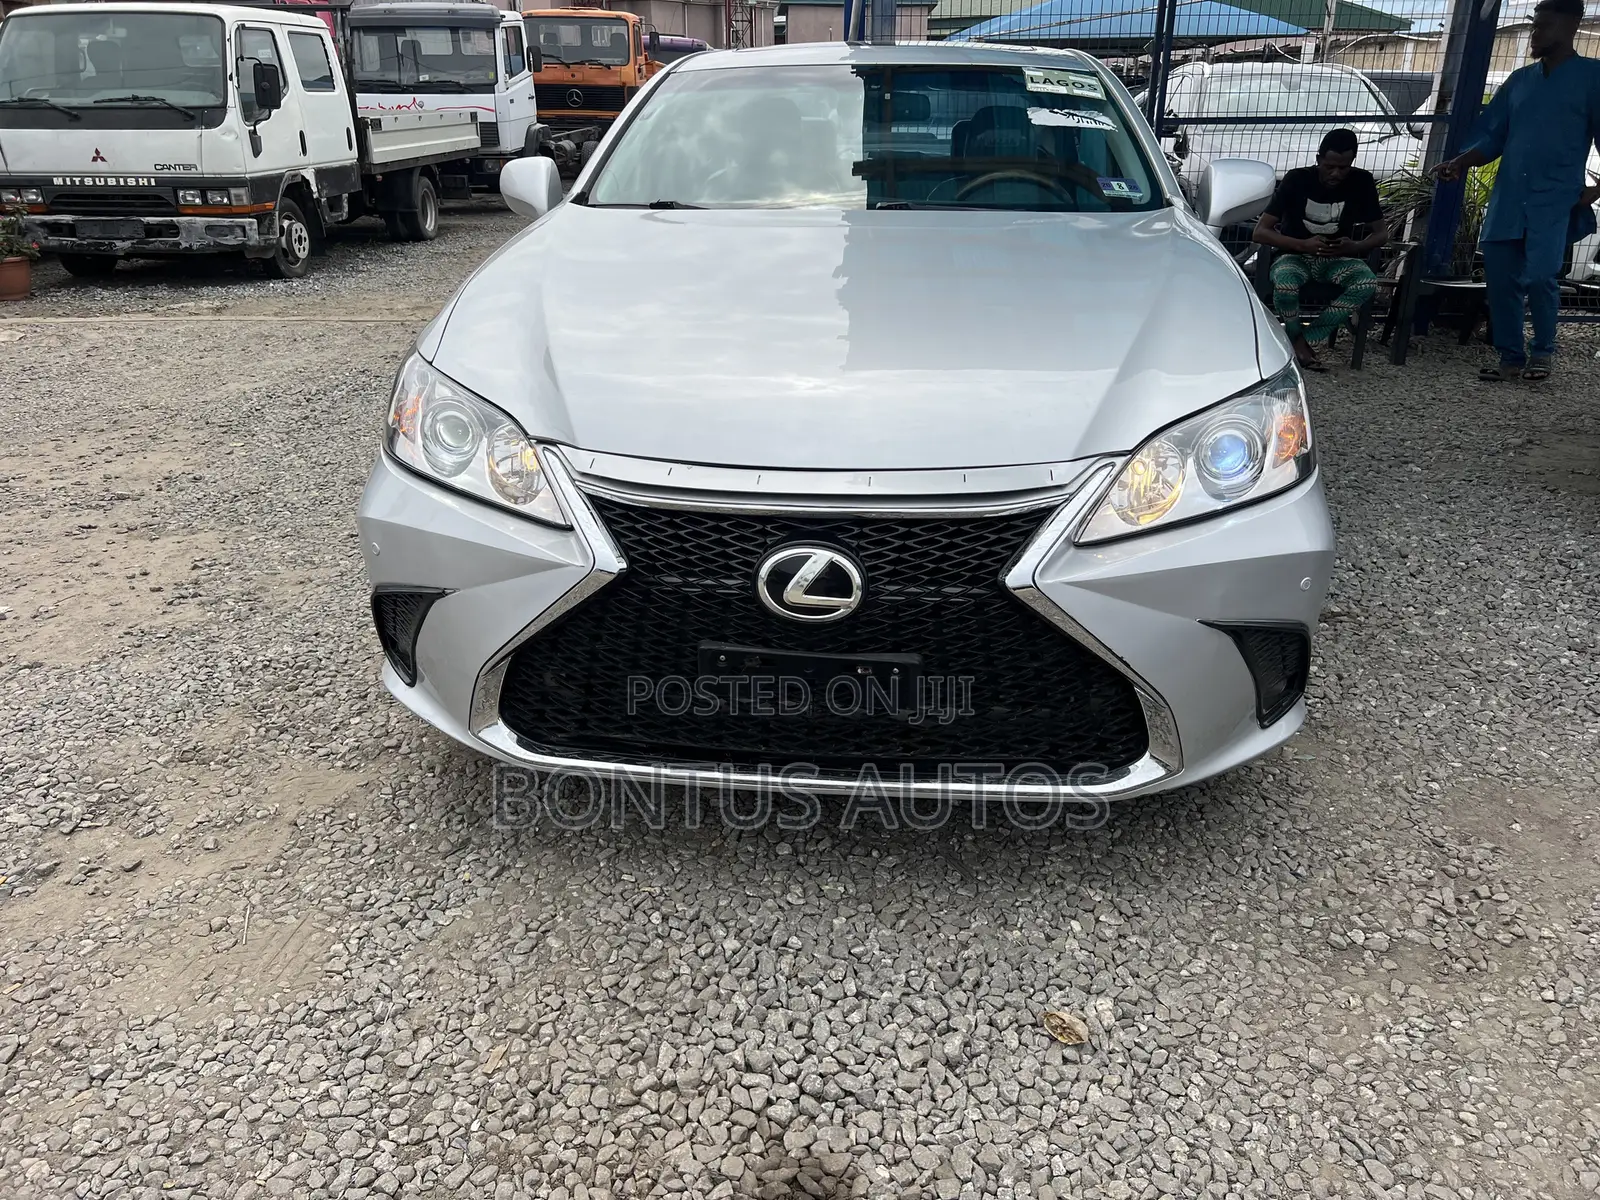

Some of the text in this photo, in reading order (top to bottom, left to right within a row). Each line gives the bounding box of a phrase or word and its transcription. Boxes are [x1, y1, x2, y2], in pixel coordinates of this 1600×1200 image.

[1029, 76, 1098, 91] LAGOS
[154, 163, 198, 172] CANTER
[53, 177, 156, 186] MITSUBISHI
